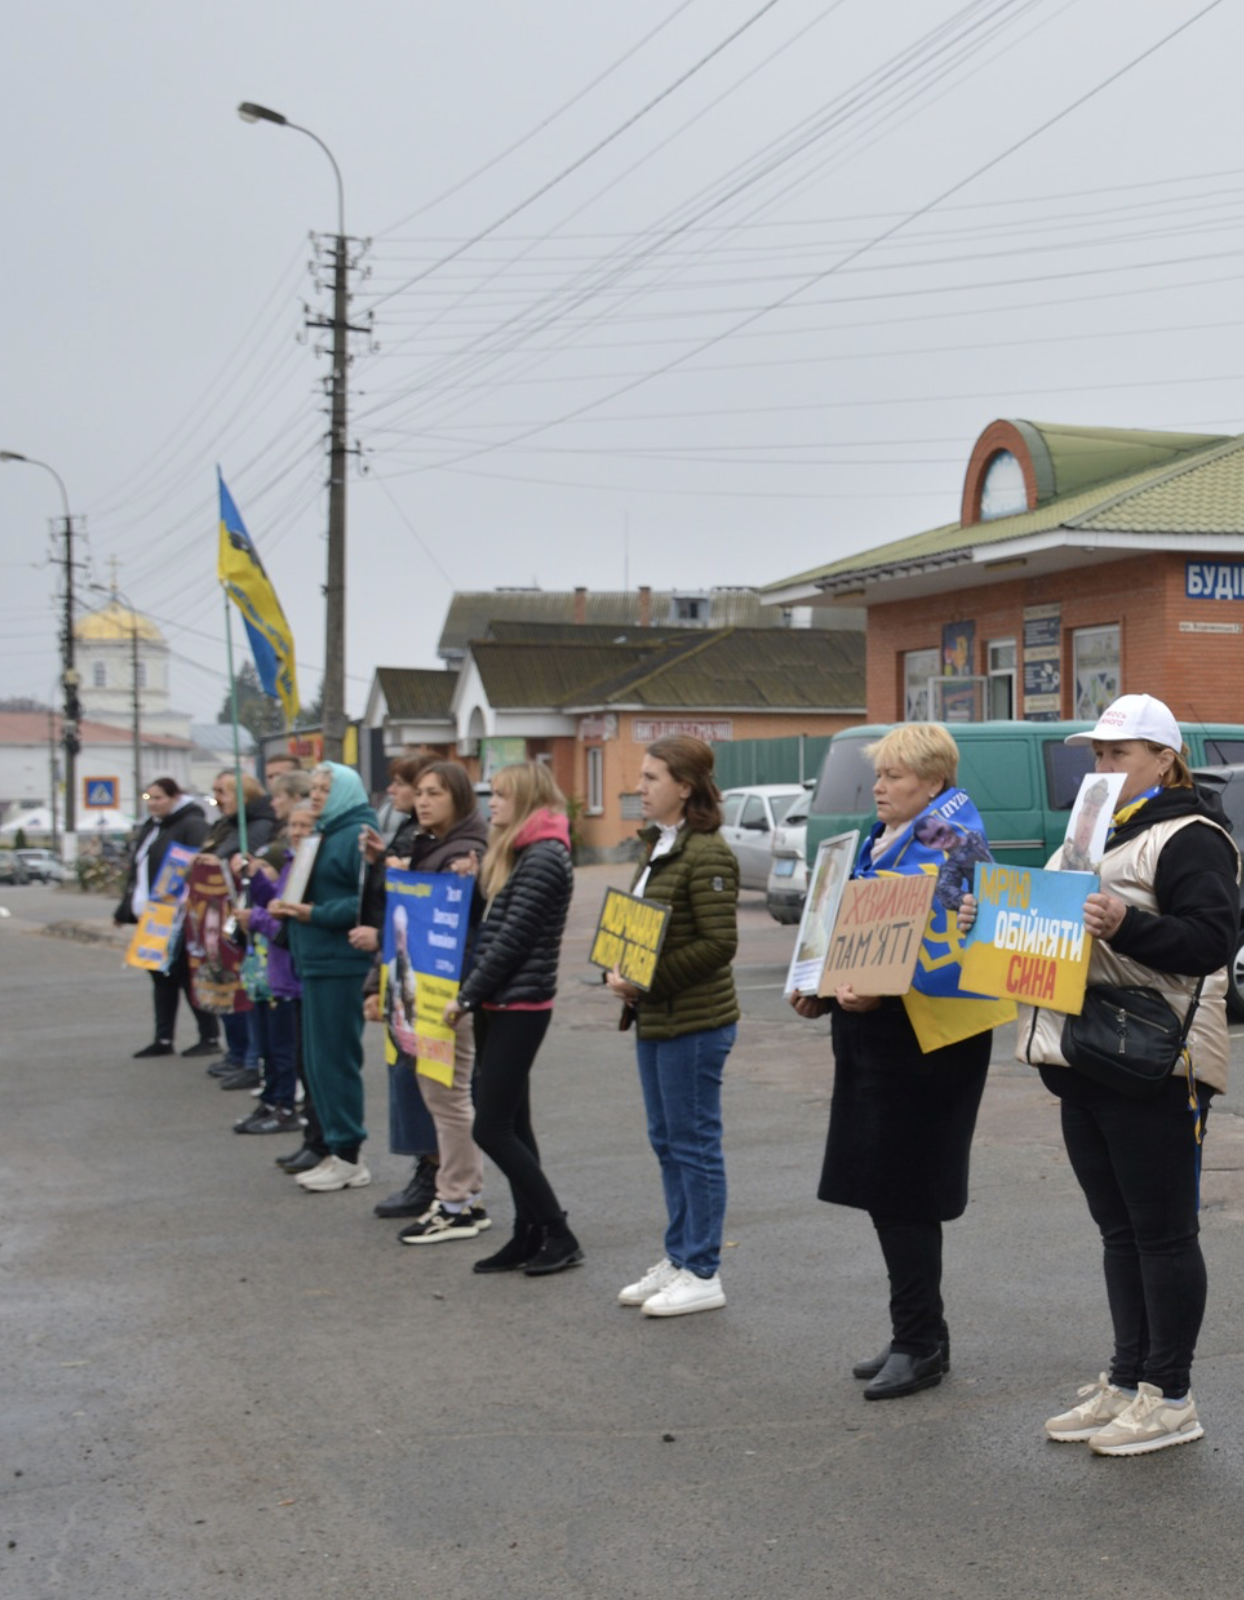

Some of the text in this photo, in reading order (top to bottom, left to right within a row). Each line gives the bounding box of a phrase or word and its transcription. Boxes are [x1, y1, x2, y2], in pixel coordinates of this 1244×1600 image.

[844, 876, 935, 925] ХВИЛИНА
[979, 868, 1031, 909] МРІЮ
[827, 919, 916, 972] ПАМ'ЯТІ
[994, 908, 1086, 962] ОБІЙНЯТИ
[1006, 955, 1057, 1000] СИНА
